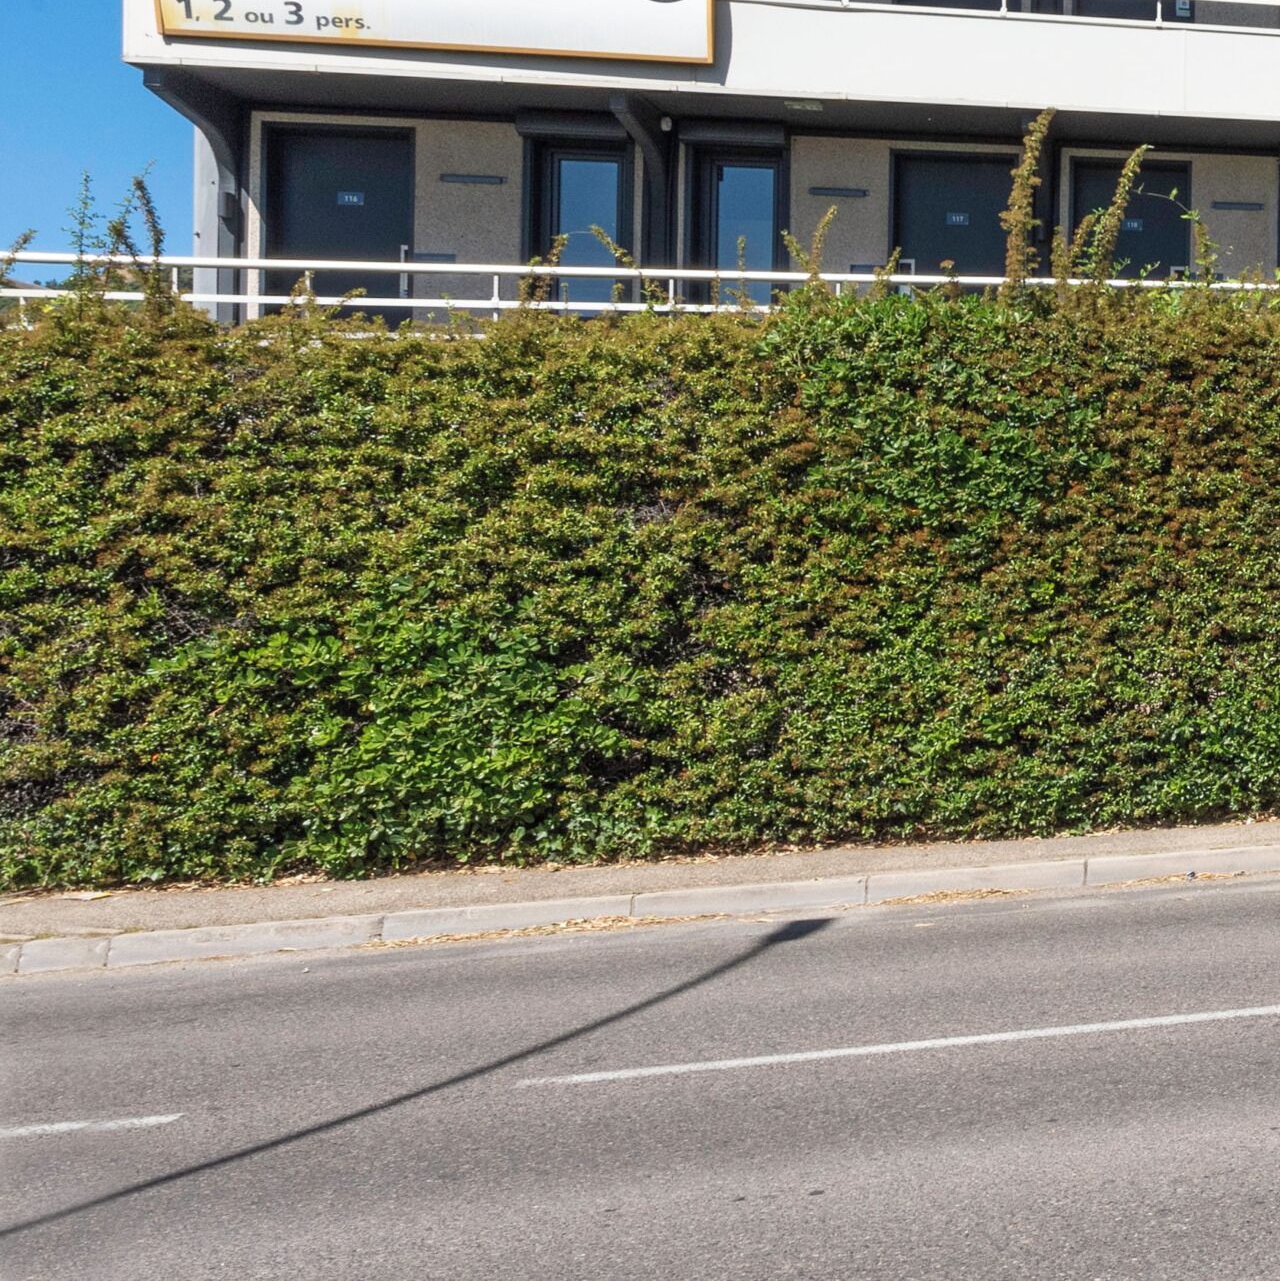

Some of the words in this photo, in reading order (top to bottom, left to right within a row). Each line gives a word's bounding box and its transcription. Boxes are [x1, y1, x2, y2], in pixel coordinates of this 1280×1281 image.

[244, 10, 274, 24] ou
[283, 1, 304, 25] 3
[315, 14, 371, 30] pers.
